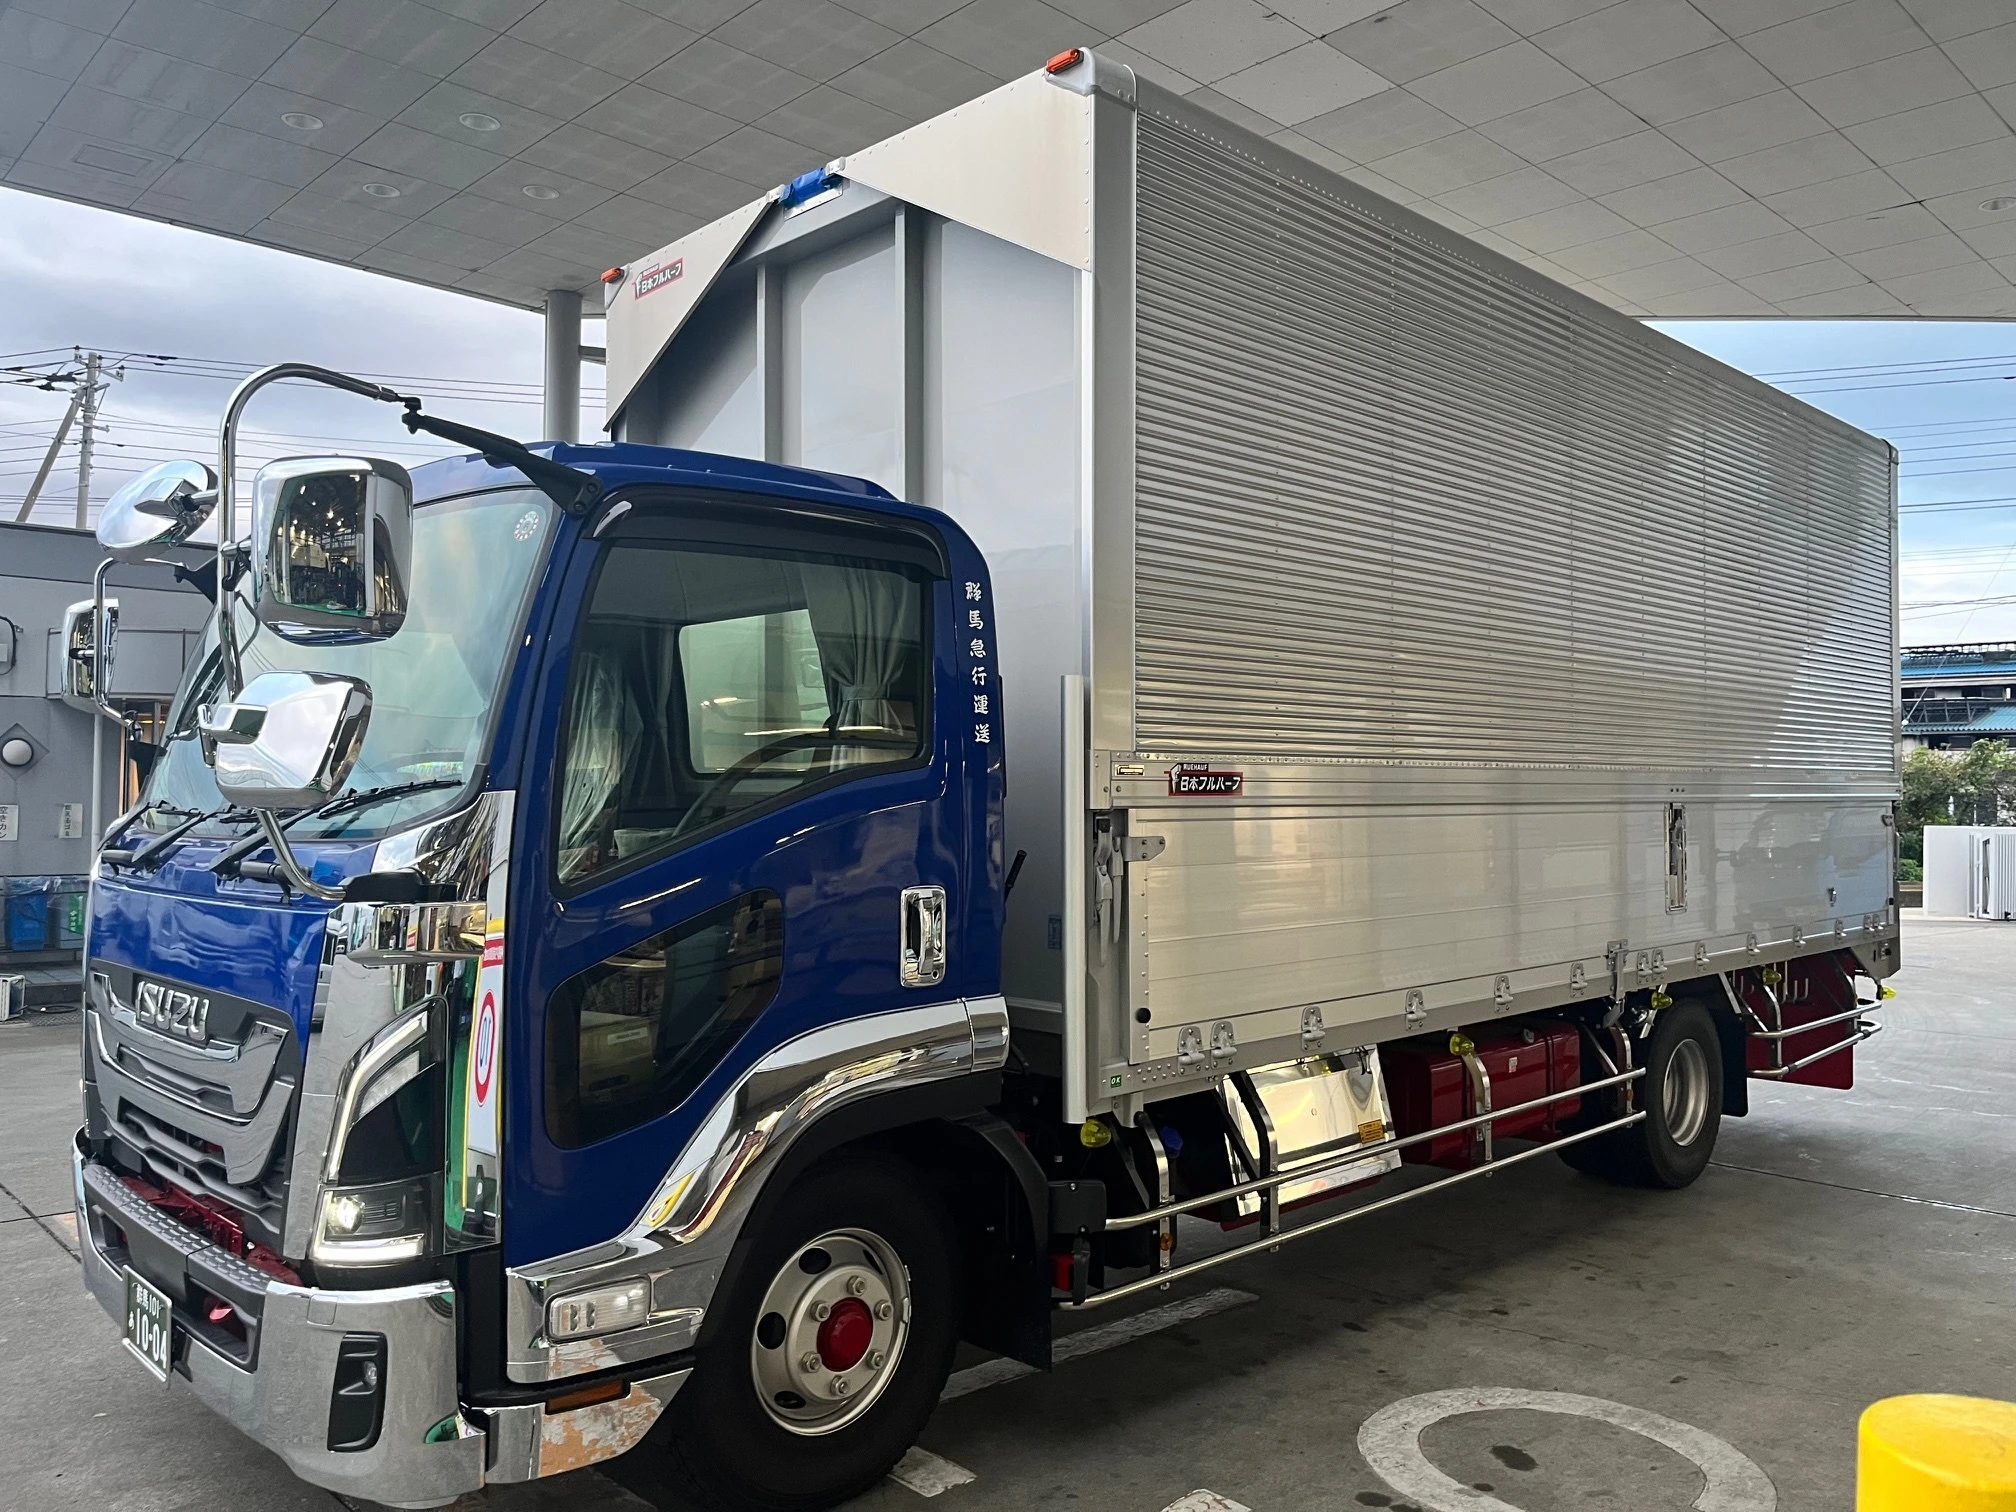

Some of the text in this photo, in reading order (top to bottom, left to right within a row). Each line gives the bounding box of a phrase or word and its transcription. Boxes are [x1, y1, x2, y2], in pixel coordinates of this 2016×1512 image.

[641, 262, 682, 294] 日本フルハーフ
[1181, 776, 1241, 791] 日本フルハーフ
[135, 981, 209, 1040] ISUZU
[1111, 1077, 1121, 1085] OK
